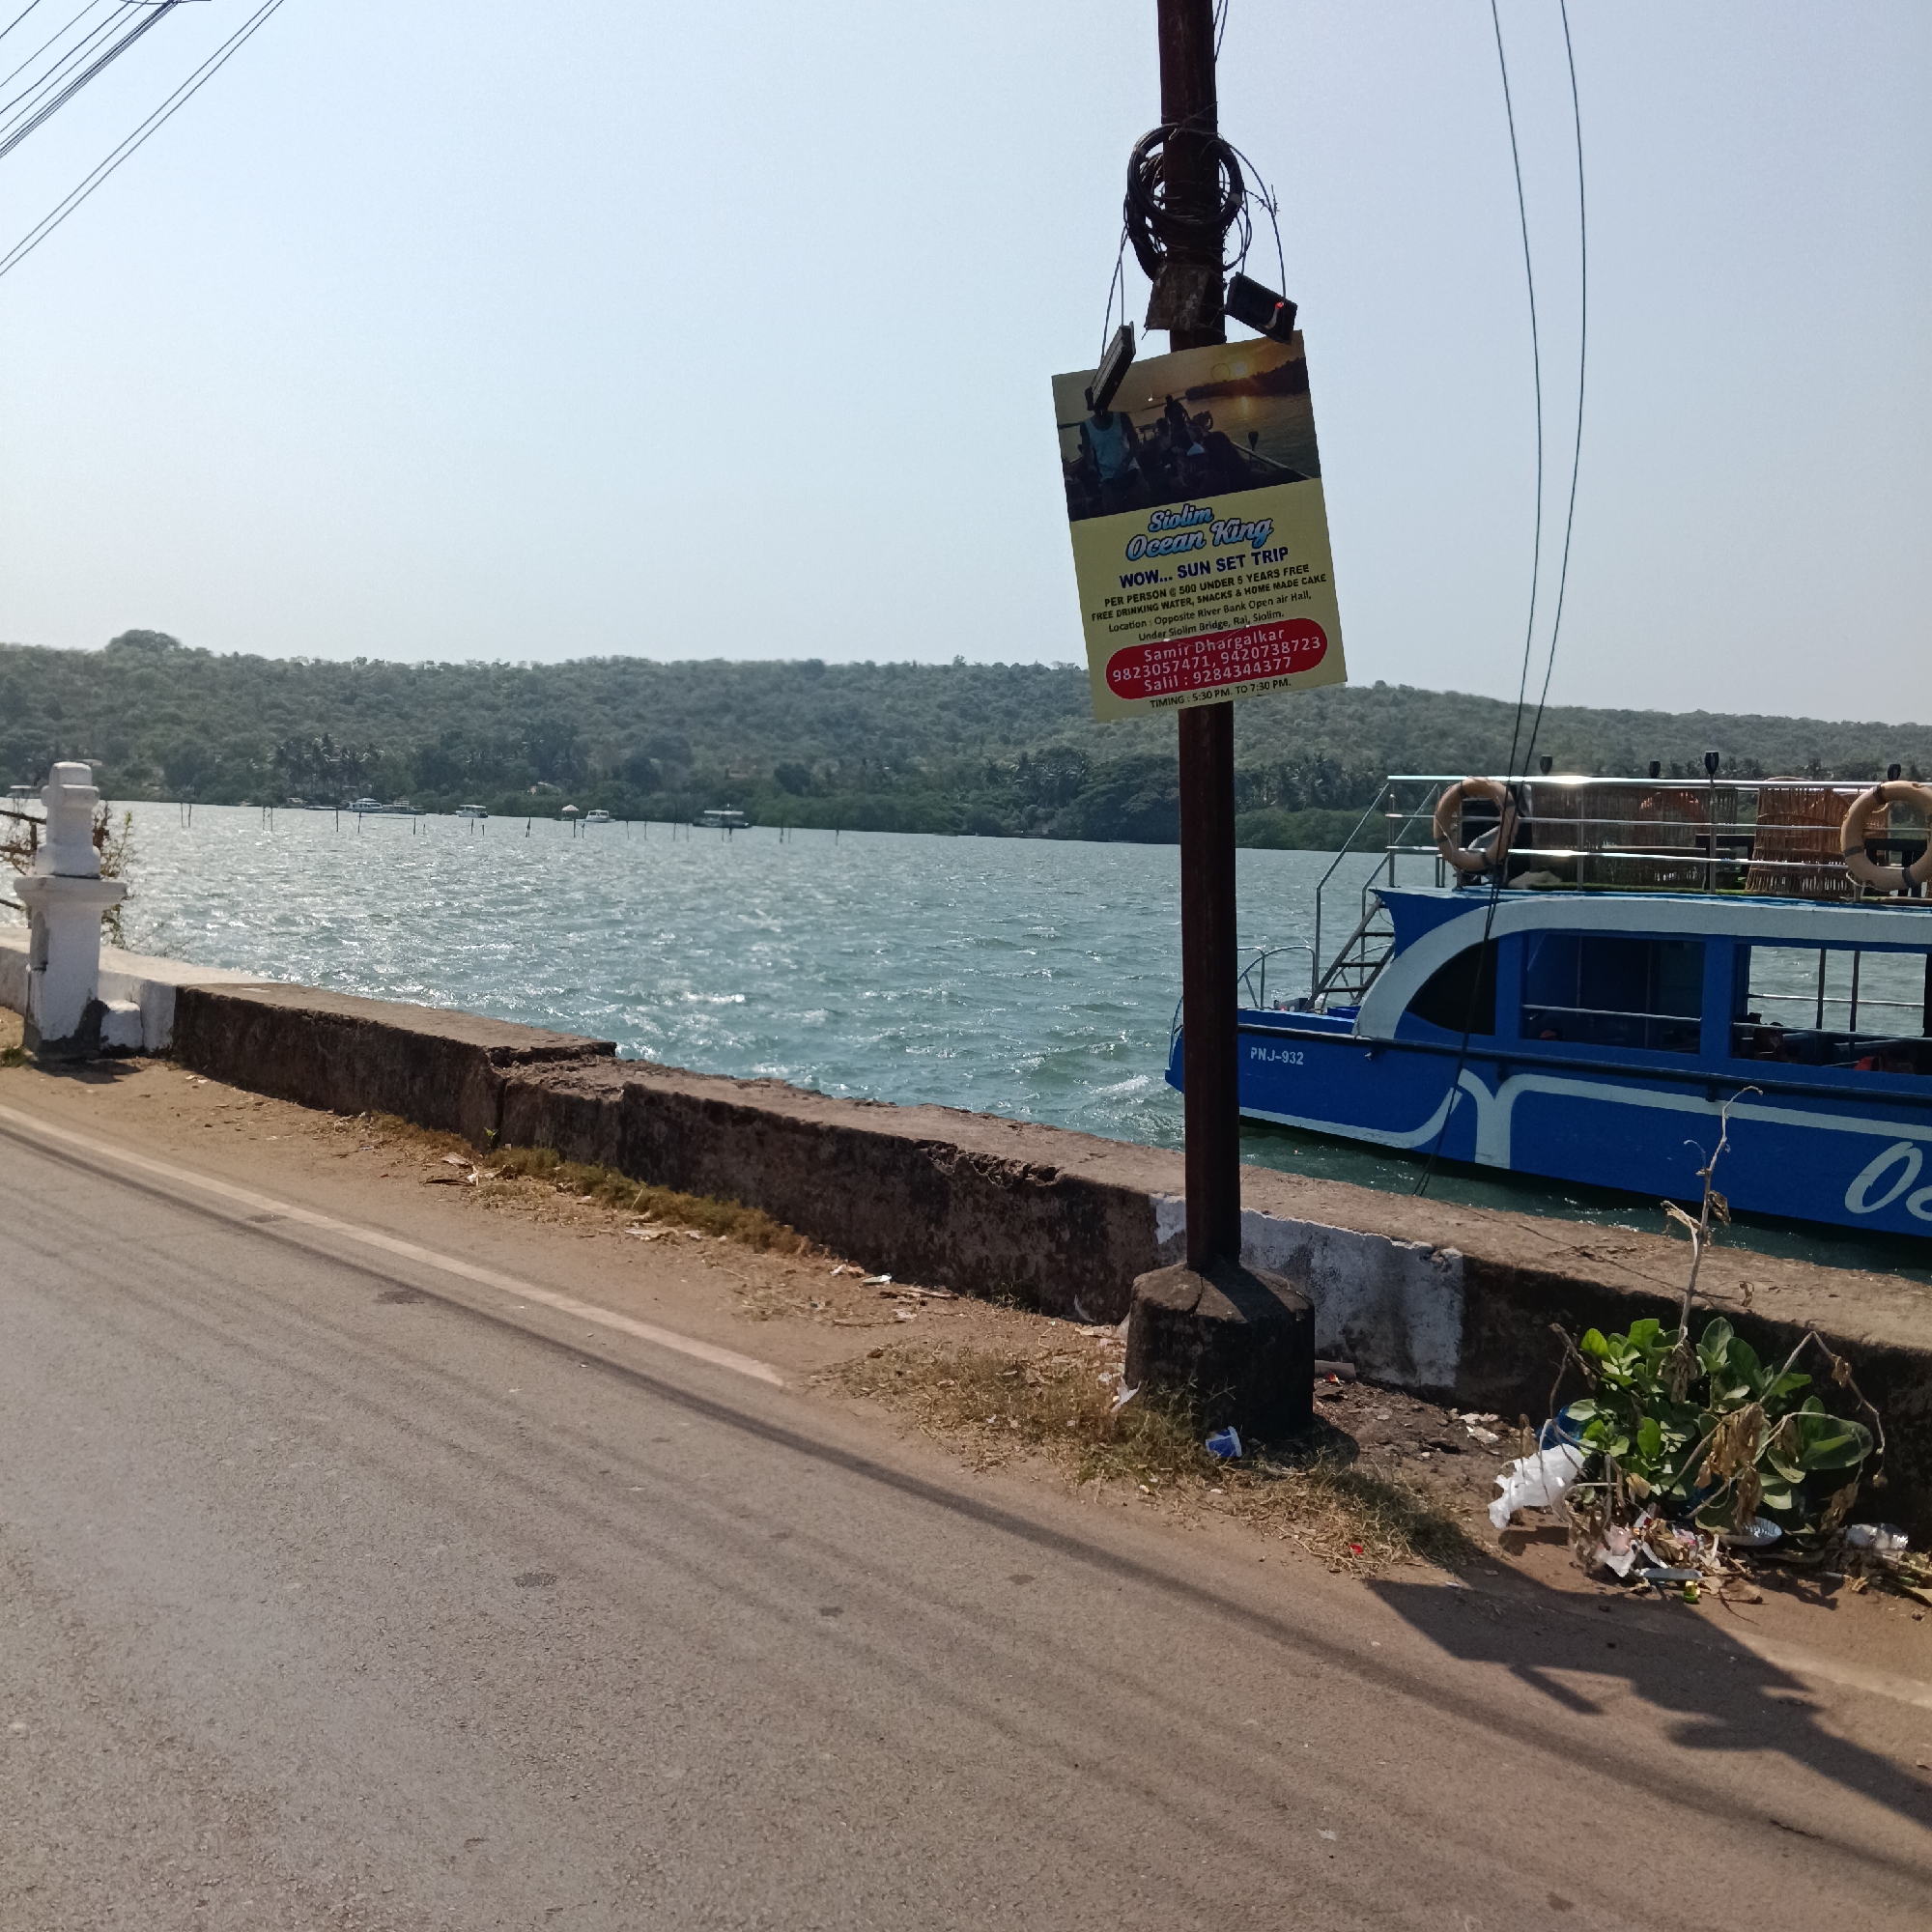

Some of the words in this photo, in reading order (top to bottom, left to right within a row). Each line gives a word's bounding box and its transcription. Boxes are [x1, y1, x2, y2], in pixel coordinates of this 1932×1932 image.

[1148, 503, 1214, 532] Siolim
[1125, 531, 1207, 561] Ocean
[1209, 518, 1274, 549] King
[1104, 596, 1124, 607] PER
[1126, 588, 1167, 604] PERSON
[1179, 583, 1197, 595] 500
[1199, 577, 1235, 591] UNDER
[1236, 575, 1243, 584] 5
[1246, 568, 1280, 582] YEARS
[1283, 563, 1310, 577] FREE
[1120, 569, 1174, 588] WOW...
[1177, 560, 1211, 579] SUN
[1215, 554, 1246, 572] SET
[1251, 547, 1289, 565] TRIP
[1092, 610, 1114, 621] FREE
[1116, 603, 1159, 618] DRINKING
[1161, 597, 1195, 611] WATER,
[1197, 589, 1233, 604] SNACKS
[1236, 588, 1242, 597] &
[1244, 582, 1271, 595] HOME
[1273, 578, 1299, 590] MADE
[1300, 573, 1327, 585] CAKE
[1108, 619, 1148, 633] Location
[1154, 611, 1196, 626] Opposite
[1197, 606, 1221, 618] River
[1223, 601, 1247, 614] Bank
[1248, 596, 1274, 611] Open
[1276, 593, 1289, 605] air
[1291, 589, 1312, 602] Hall,
[1138, 630, 1167, 641] Under
[1168, 624, 1198, 637] Siolim
[1199, 618, 1231, 632] Bridge,
[1253, 610, 1285, 623] Siolim.
[1112, 655, 1217, 683] 9823057471,
[1220, 636, 1321, 666] 9420738723
[1144, 643, 1189, 663] Samir
[1194, 629, 1285, 654] Dhargalkar
[1144, 674, 1179, 692] Salil
[1192, 656, 1293, 685] 9284344377
[1150, 696, 1185, 709] TIMING
[1192, 690, 1213, 702] 5:30
[1214, 687, 1233, 698] PM.
[1235, 685, 1248, 695] TO
[1249, 681, 1271, 693] 7:30
[1272, 677, 1292, 690] PM.
[1250, 1046, 1305, 1065] PNJ-932
